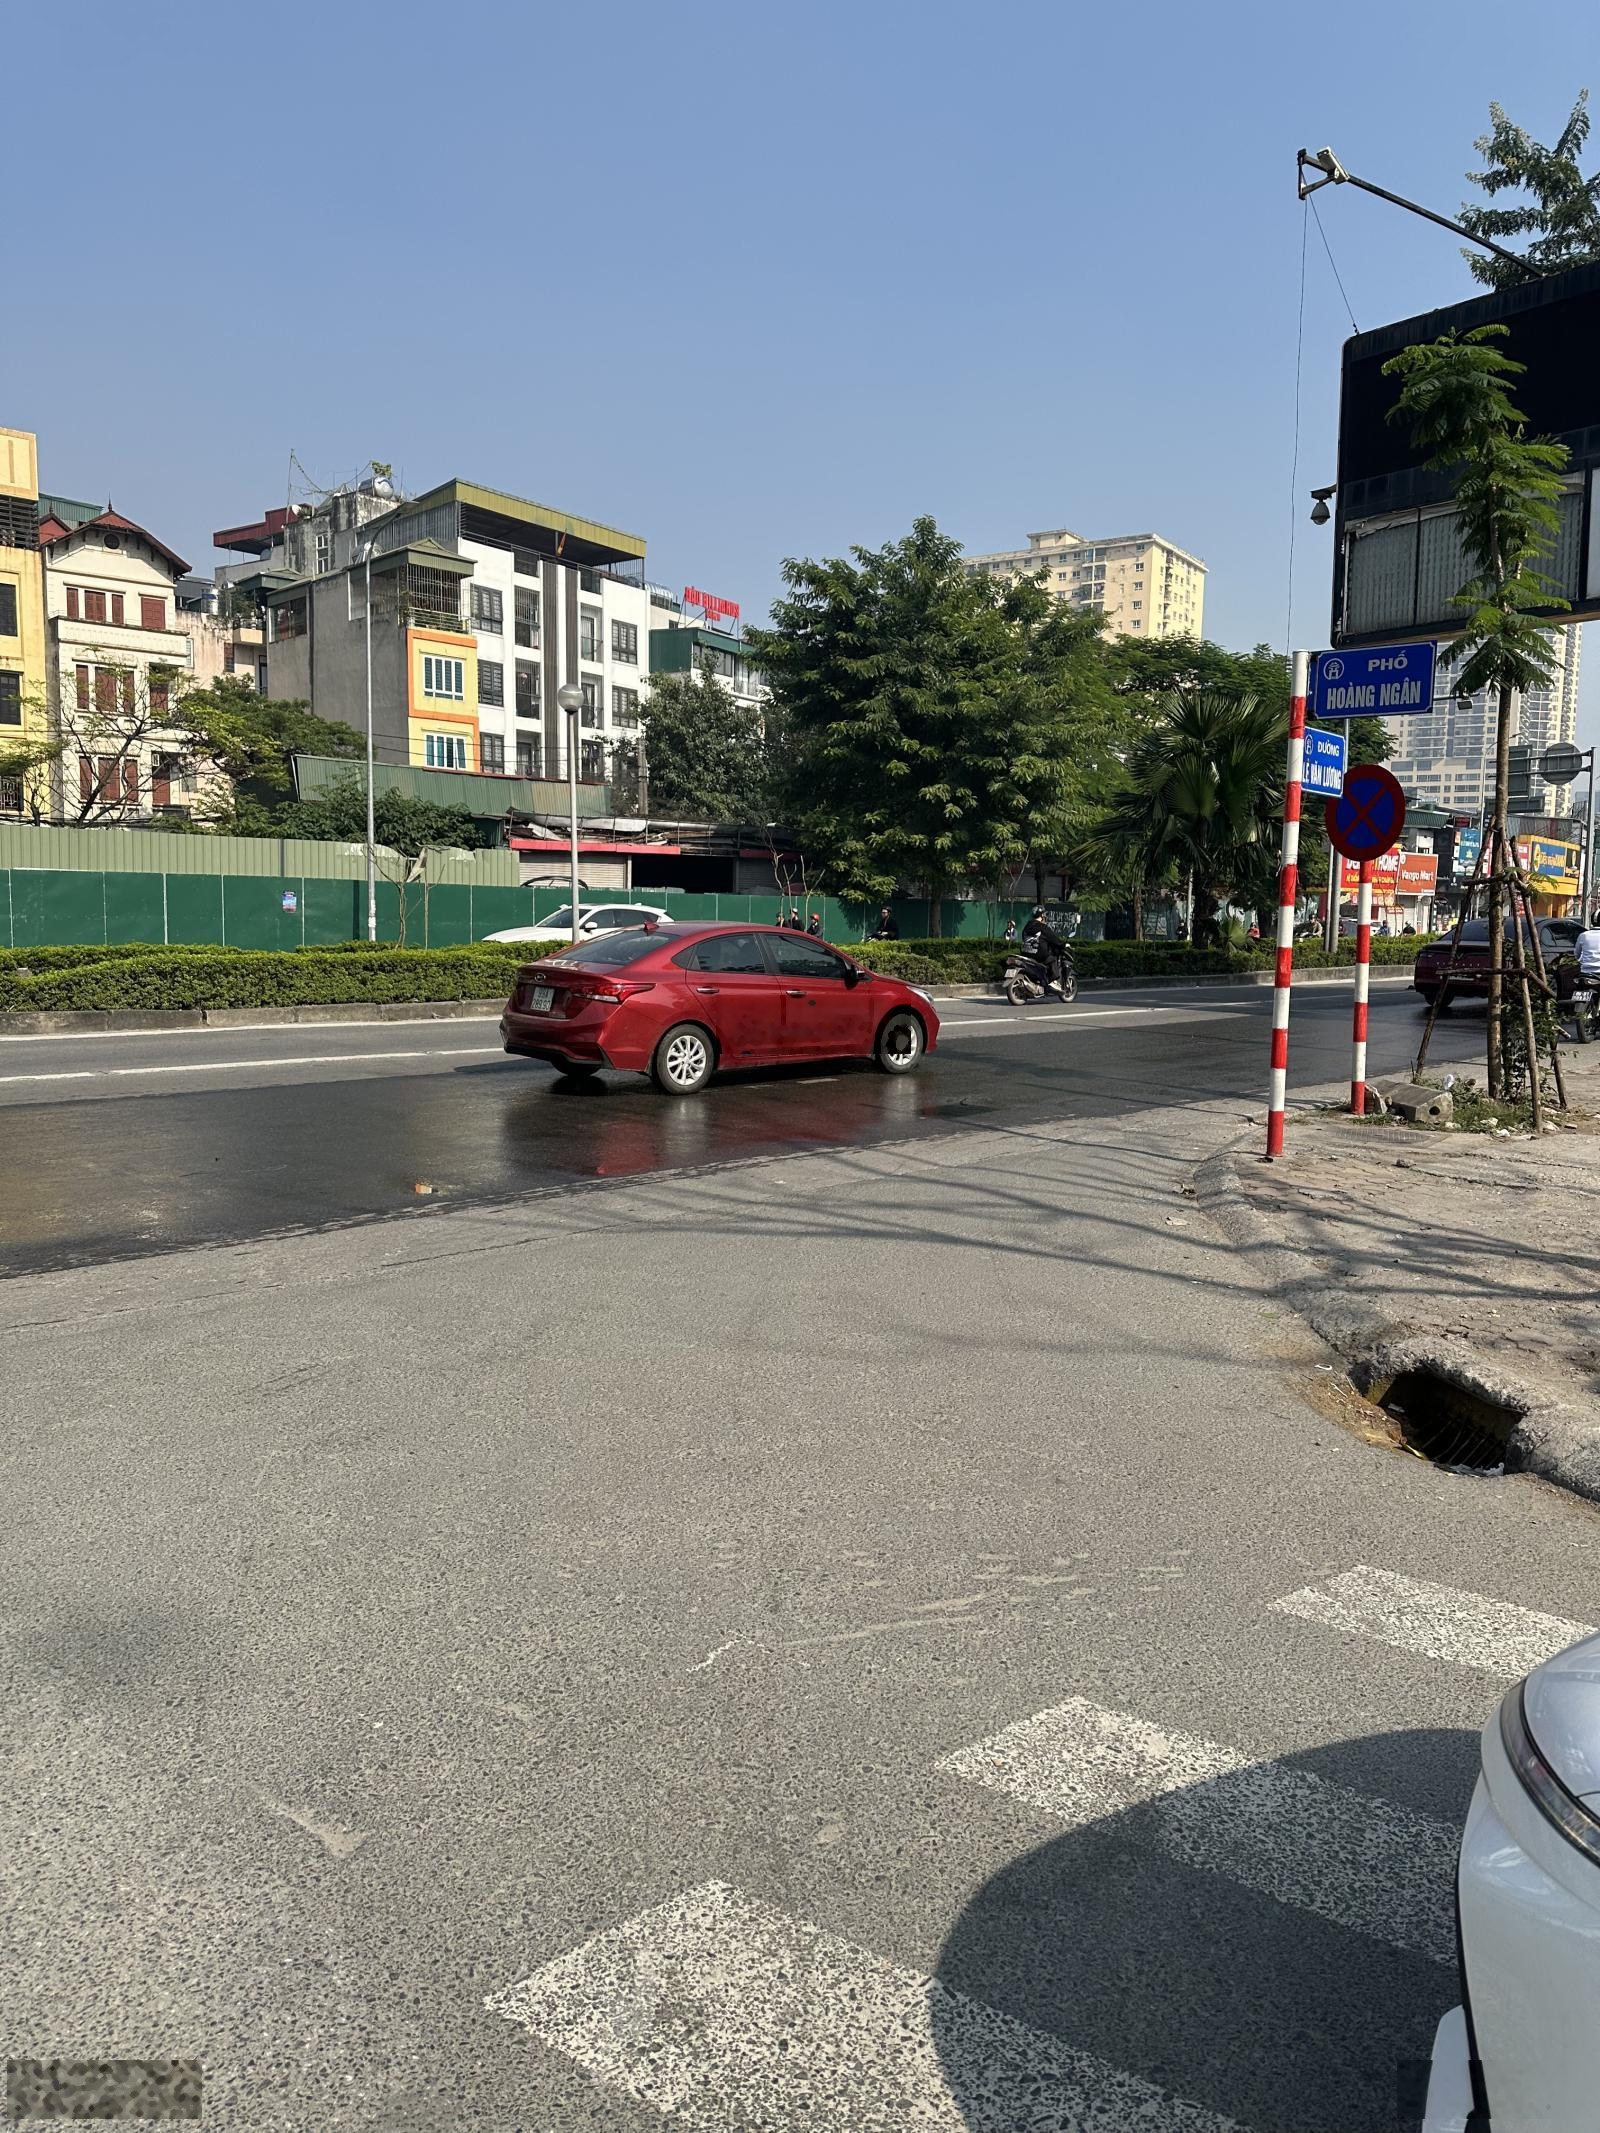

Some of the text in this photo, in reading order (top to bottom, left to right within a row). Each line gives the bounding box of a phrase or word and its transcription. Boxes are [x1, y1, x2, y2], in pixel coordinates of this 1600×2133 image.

[1368, 650, 1408, 671] PHỐ
[1327, 677, 1421, 709] HOÀNG NGÂN
[1317, 740, 1339, 757] ĐƯỜNG
[1310, 760, 1323, 785] VĂN
[1323, 766, 1342, 790] LƯƠNG
[1420, 870, 1434, 881] Mart
